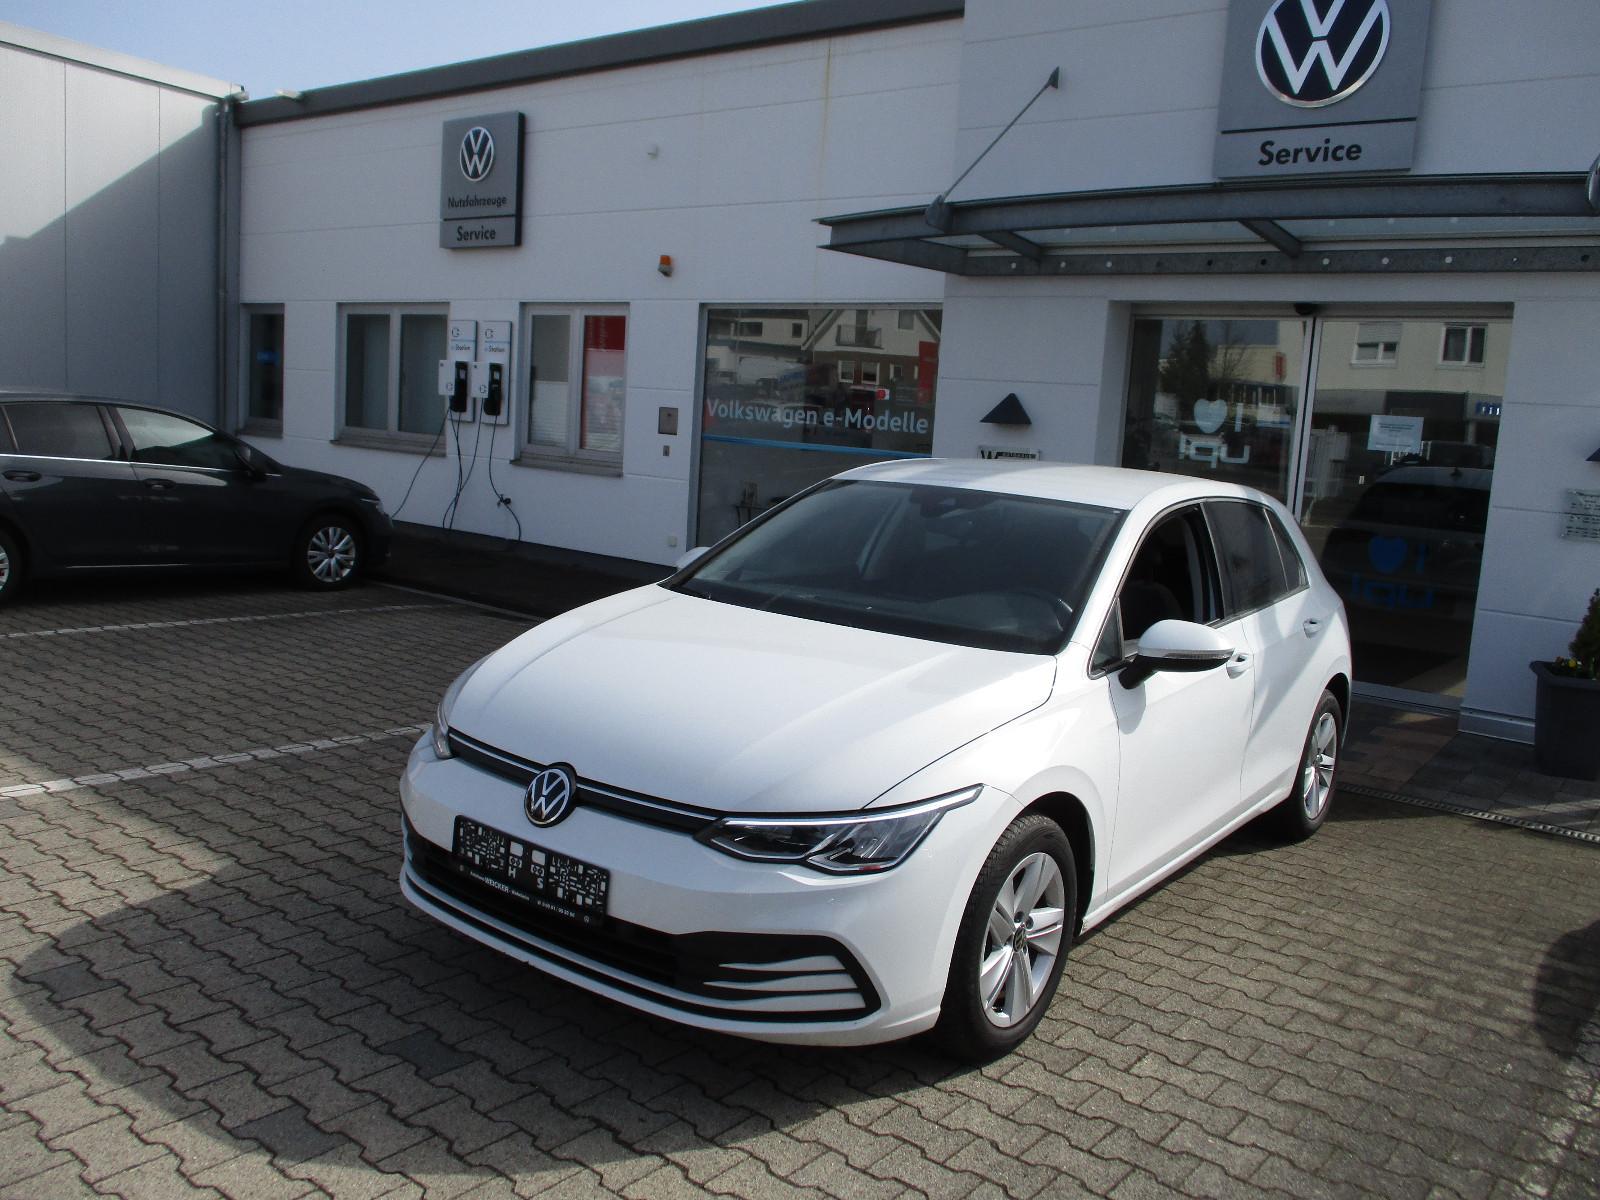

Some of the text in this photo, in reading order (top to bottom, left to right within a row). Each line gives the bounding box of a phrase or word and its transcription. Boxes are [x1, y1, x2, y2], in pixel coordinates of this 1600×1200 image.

[460, 126, 494, 181] VW
[1258, 138, 1362, 166] Service
[448, 195, 507, 208] Nutzfahrzeuge
[457, 225, 496, 241] Service
[706, 399, 929, 435] Volkswagen e-Modelle
[525, 768, 570, 824] VW
